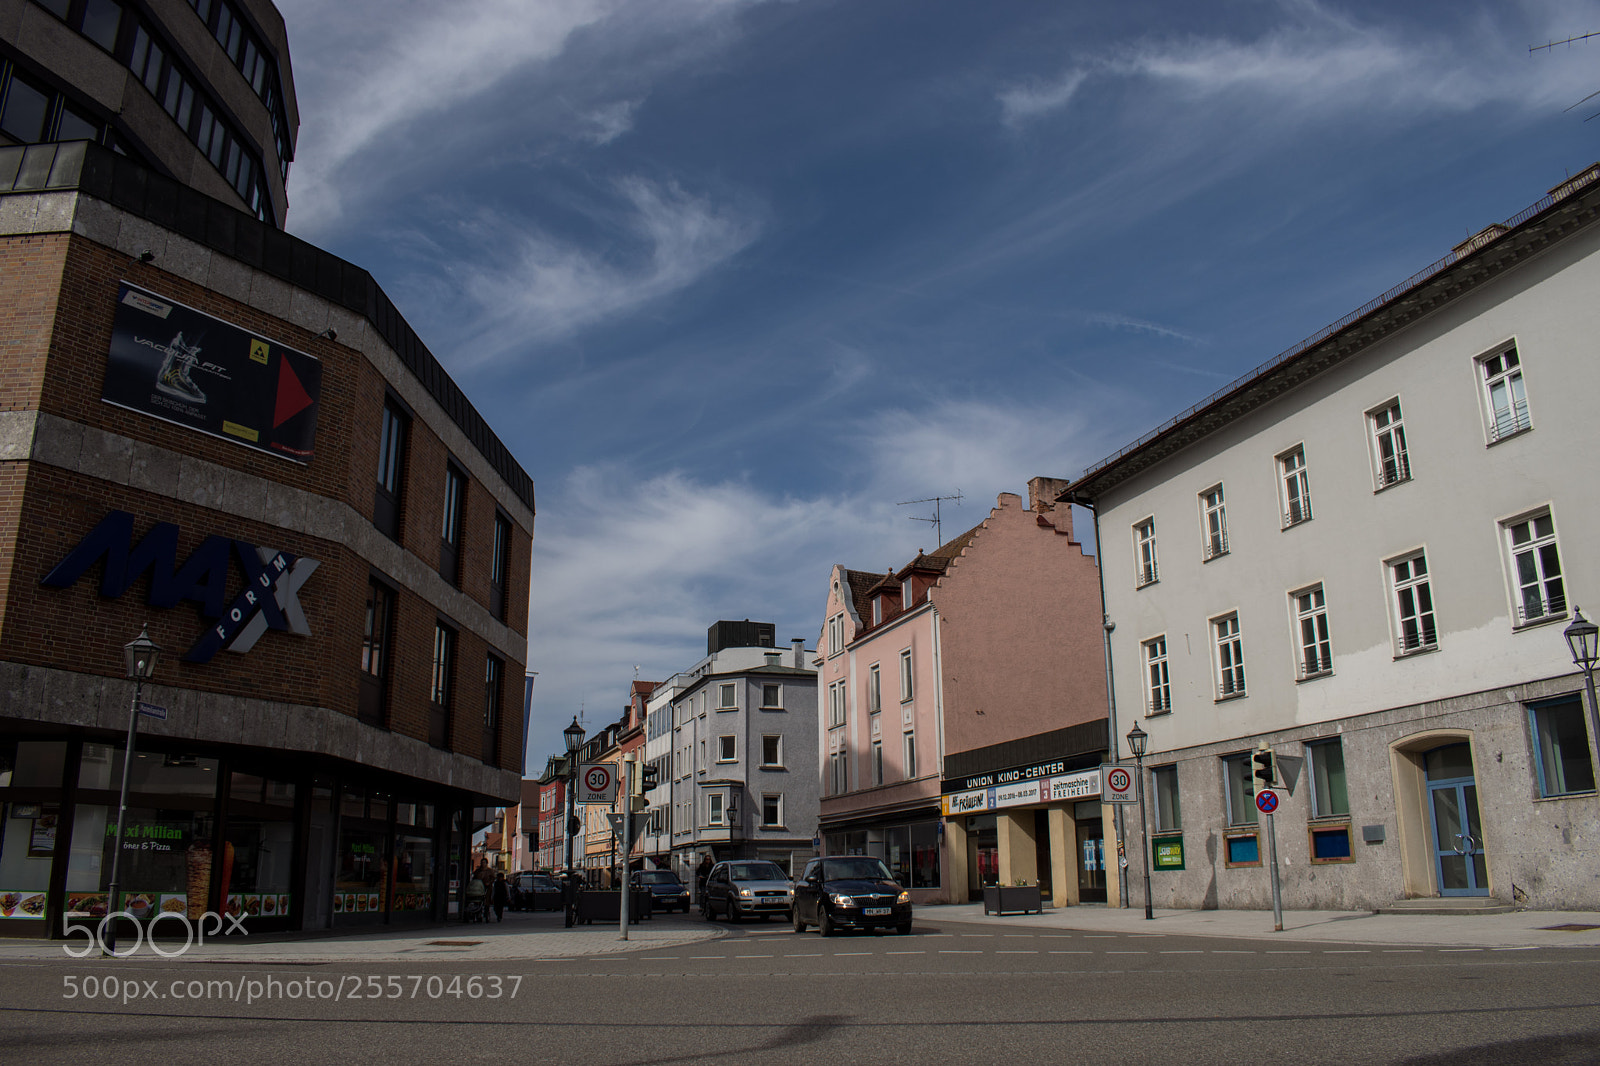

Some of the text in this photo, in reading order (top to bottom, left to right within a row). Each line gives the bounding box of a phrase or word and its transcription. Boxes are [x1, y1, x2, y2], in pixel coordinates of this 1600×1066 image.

[201, 361, 228, 373] FIT
[216, 553, 287, 640] FORUM
[590, 773, 605, 786] 30
[966, 762, 1064, 789] UNION KINO-CENTER
[1113, 775, 1126, 786] 30
[1053, 777, 1089, 791] zeitmaschine
[1043, 790, 1048, 800] 3
[1053, 786, 1089, 798] FREIHEIT
[106, 824, 182, 840] Mxi Milian
[121, 841, 171, 851] öner & Pizza
[1159, 846, 1181, 856] SUBWAY
